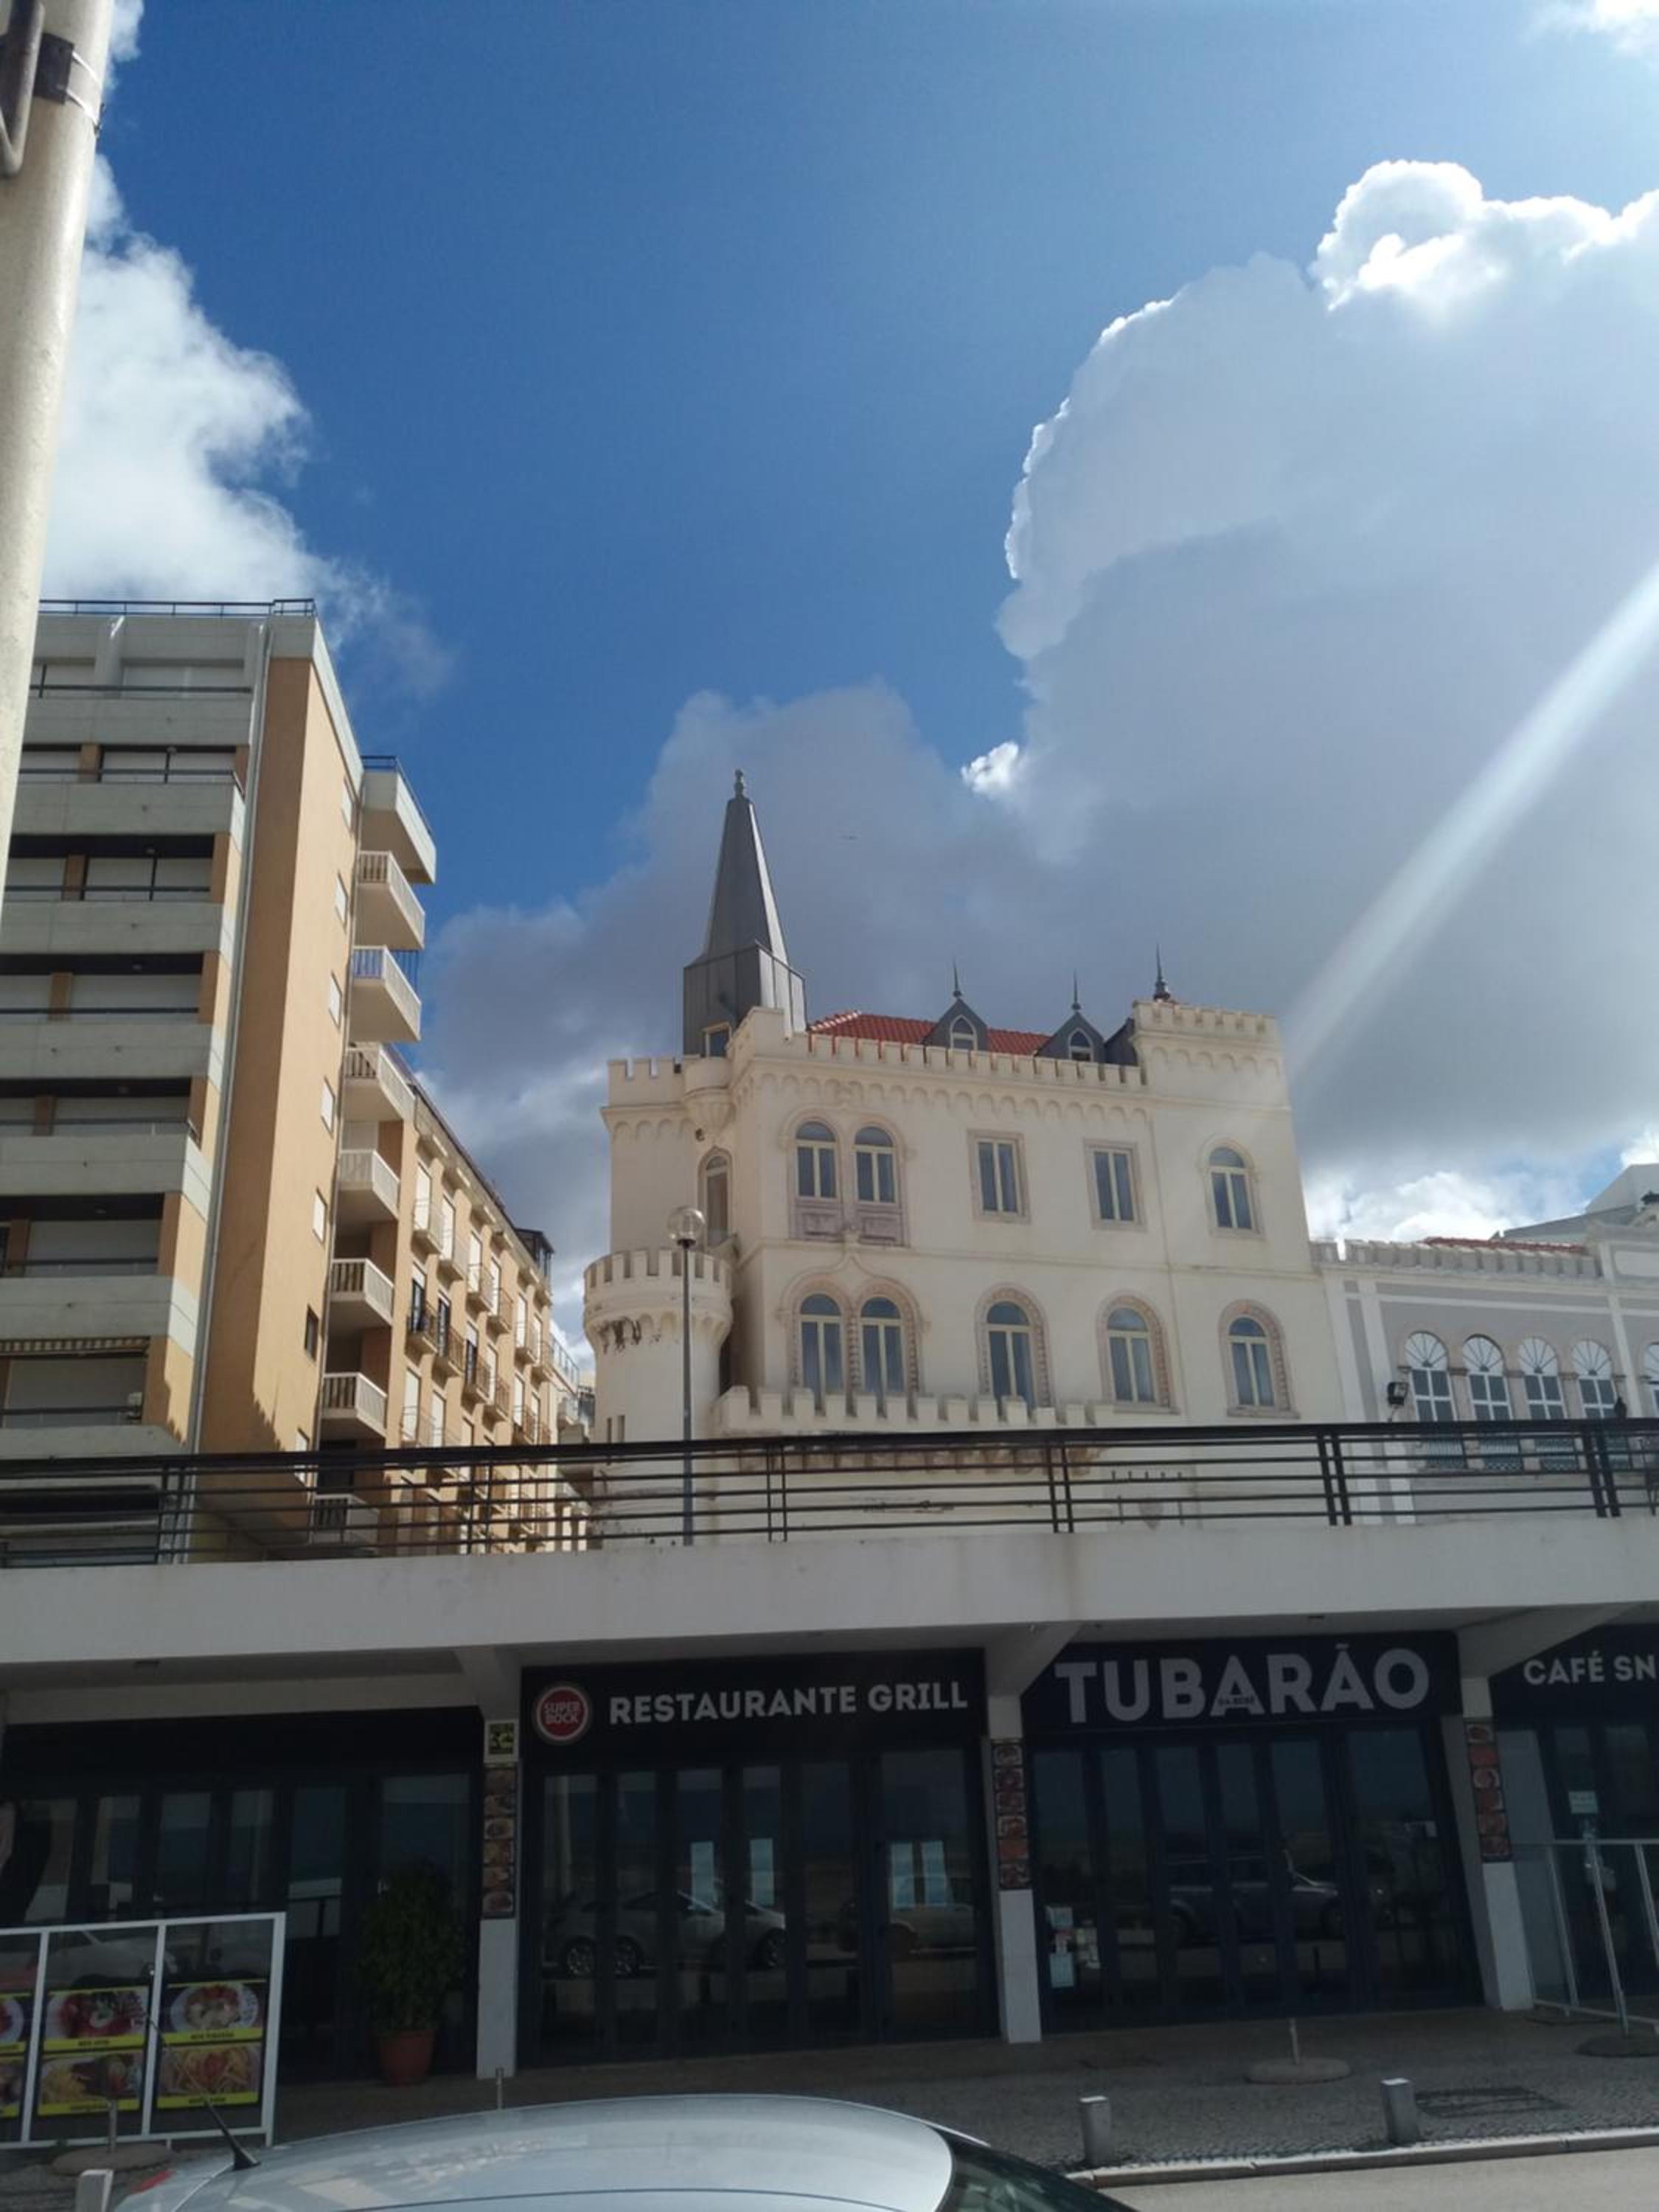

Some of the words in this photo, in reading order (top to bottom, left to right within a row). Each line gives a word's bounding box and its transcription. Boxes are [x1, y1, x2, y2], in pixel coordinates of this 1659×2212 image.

[1054, 1643, 1430, 1723] TUBARÃO
[1523, 1649, 1606, 1686] CAFÉ
[610, 1686, 858, 1726] RESTAURANTE
[867, 1681, 969, 1713] GRILL
